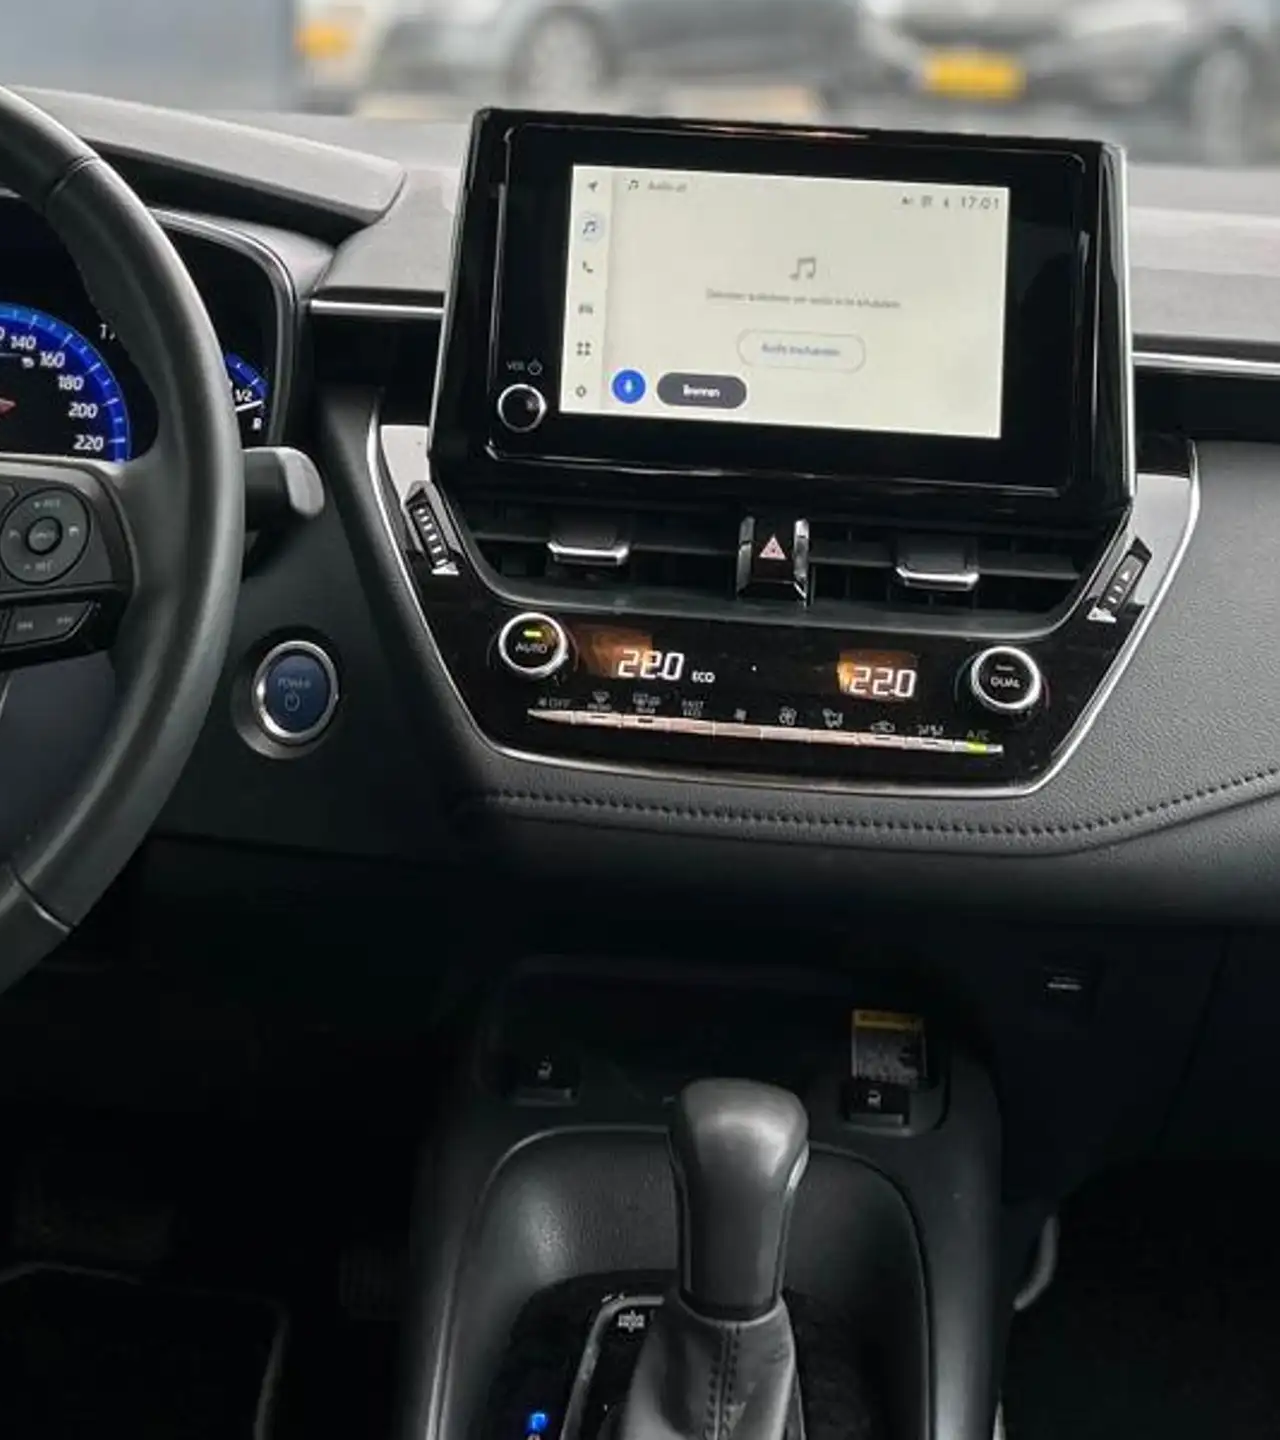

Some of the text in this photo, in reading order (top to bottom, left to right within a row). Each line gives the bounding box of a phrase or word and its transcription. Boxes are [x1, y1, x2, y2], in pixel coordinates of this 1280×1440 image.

[10, 335, 37, 350] 140
[40, 351, 66, 369] 160
[58, 374, 85, 391] 180
[68, 402, 98, 419] 200
[73, 435, 104, 452] 220
[515, 642, 548, 655] AUTO
[691, 670, 716, 683] ECO
[989, 676, 1022, 689] DUAL
[548, 697, 571, 709] OFF
[965, 728, 992, 742] A/C
